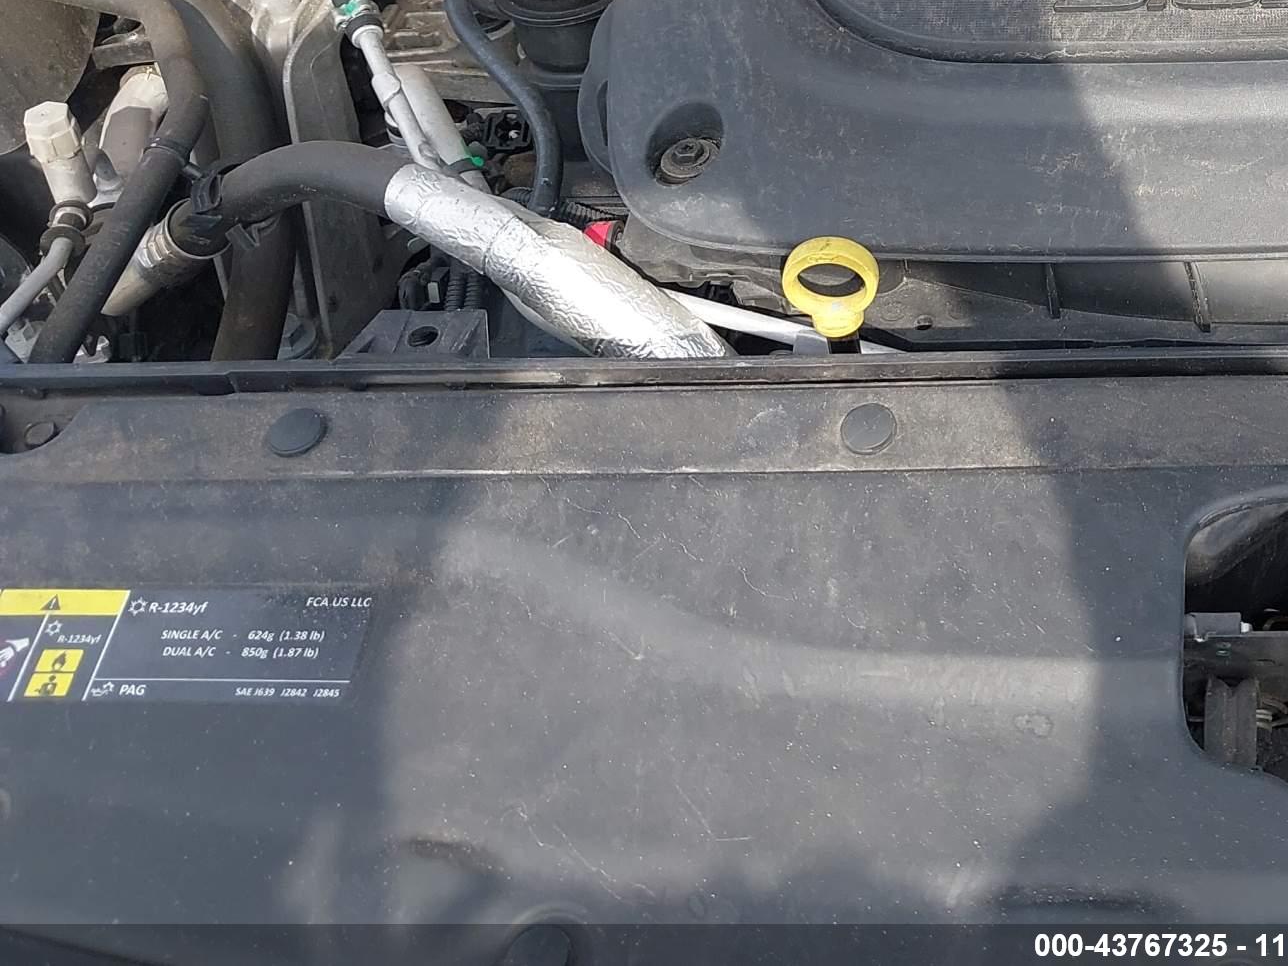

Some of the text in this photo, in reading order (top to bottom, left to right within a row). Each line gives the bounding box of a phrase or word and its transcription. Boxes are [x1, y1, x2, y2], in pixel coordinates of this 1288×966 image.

[148, 601, 208, 615] R-1234yf
[306, 596, 372, 608] FCA US LLC
[57, 634, 102, 645] R-1234yf
[160, 629, 200, 640] SINGLE
[200, 629, 223, 642] A/C
[247, 630, 274, 642] 624g
[279, 630, 308, 642] (1.38
[310, 630, 325, 642] lb)
[162, 646, 192, 658] DUAL
[193, 646, 216, 659] A/C
[241, 646, 269, 659] 850g
[272, 647, 301, 659] (1.87
[303, 647, 320, 659] lb)
[119, 684, 147, 696] PAG
[235, 687, 340, 697] SAE J639 J2842 J2845
